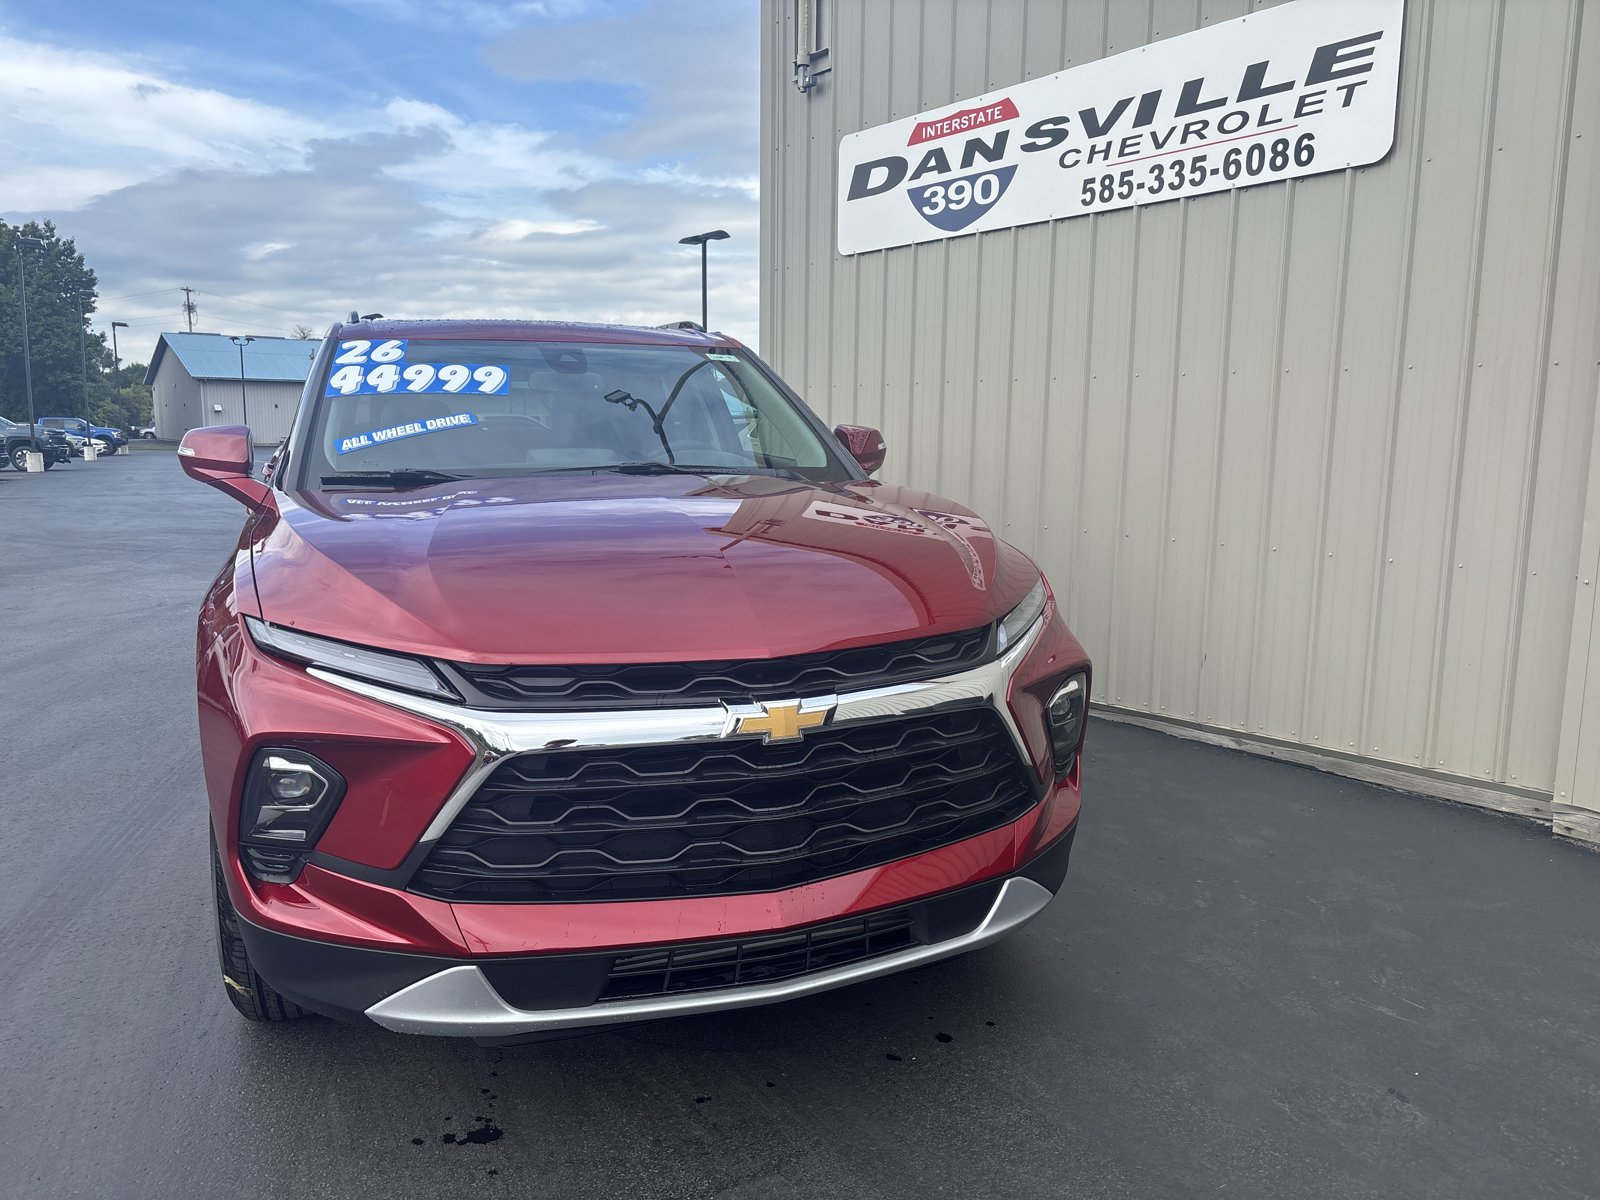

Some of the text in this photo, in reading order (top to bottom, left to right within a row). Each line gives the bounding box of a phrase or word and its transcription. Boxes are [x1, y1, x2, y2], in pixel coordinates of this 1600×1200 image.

[921, 106, 1003, 139] INTERSTATE
[1058, 80, 1368, 170] CHEVROLET
[1080, 132, 1316, 207] 585-335-6086
[921, 174, 1000, 216] 390
[335, 339, 405, 365] 26
[330, 364, 507, 394] 44999
[341, 413, 472, 451] ALL WHEEL DRIVE
